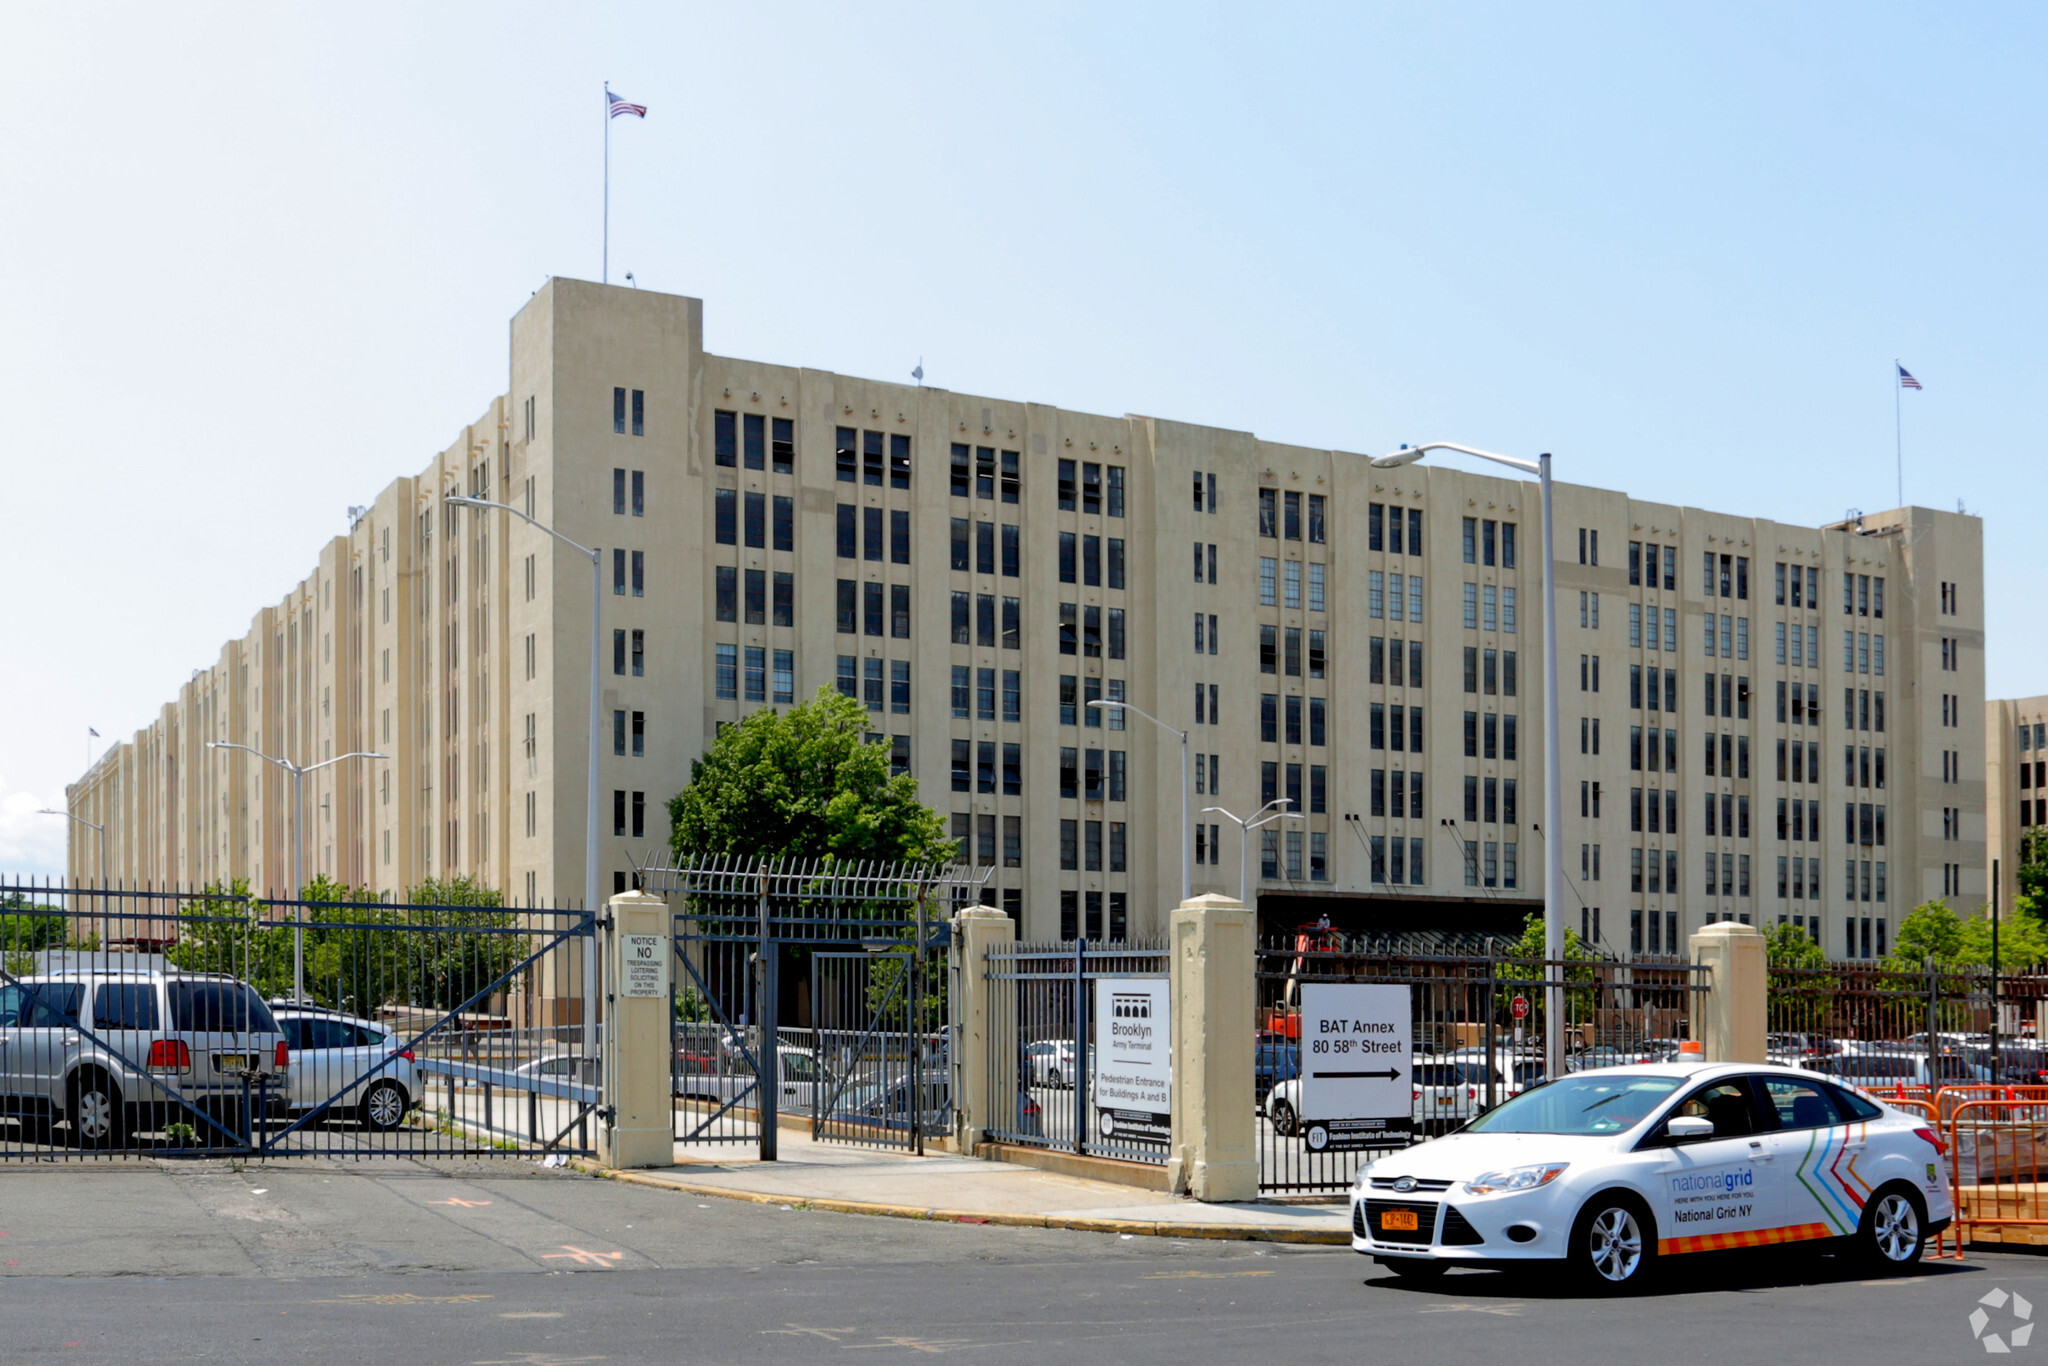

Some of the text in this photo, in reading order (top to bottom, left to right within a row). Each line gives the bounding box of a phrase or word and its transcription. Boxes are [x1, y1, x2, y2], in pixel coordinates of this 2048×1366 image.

[631, 937, 657, 946] NOTICE
[637, 947, 652, 958] NO
[1112, 1022, 1152, 1040] Brooklyn
[1320, 1019, 1395, 1034] BAT Annex
[1112, 1040, 1152, 1051] Army Terminal
[1312, 1038, 1402, 1054] 80 58th Street
[1100, 1073, 1165, 1088] Pedestrian Entrance
[1099, 1087, 1167, 1102] for Buildings A and B
[1312, 1132, 1323, 1143] FIT
[1672, 1168, 1753, 1191] nationalgrid
[1675, 1204, 1753, 1223] National Grid NY
